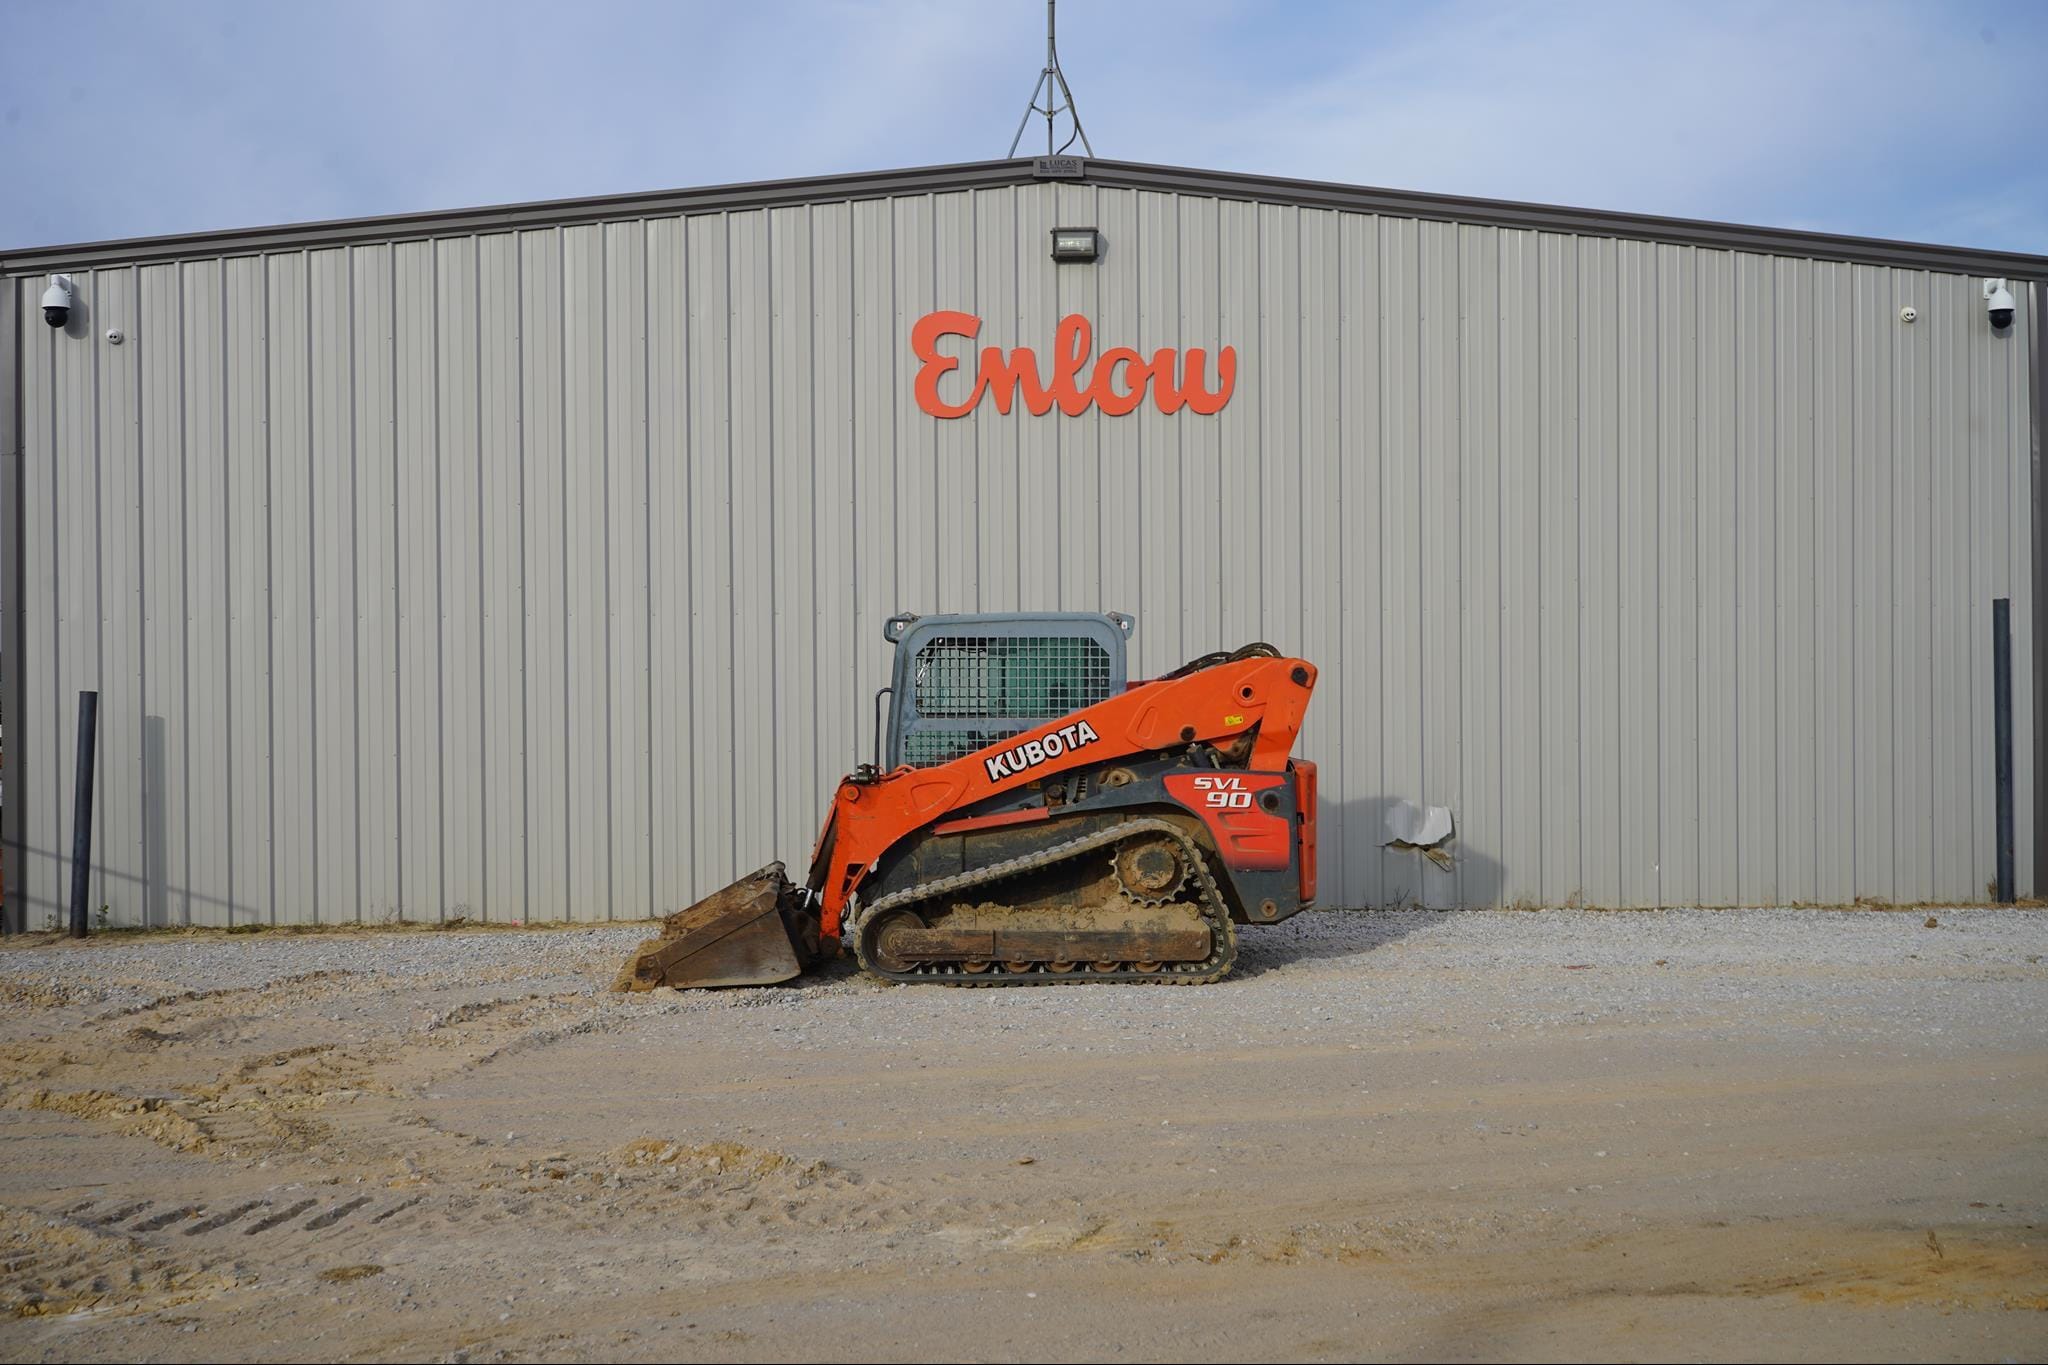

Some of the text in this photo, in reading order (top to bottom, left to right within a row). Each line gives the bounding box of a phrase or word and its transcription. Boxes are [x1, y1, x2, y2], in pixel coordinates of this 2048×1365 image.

[911, 310, 1237, 418] Enlow
[985, 720, 1099, 782] KUBOTA
[1194, 777, 1248, 790] SVL
[1205, 791, 1252, 808] 90
